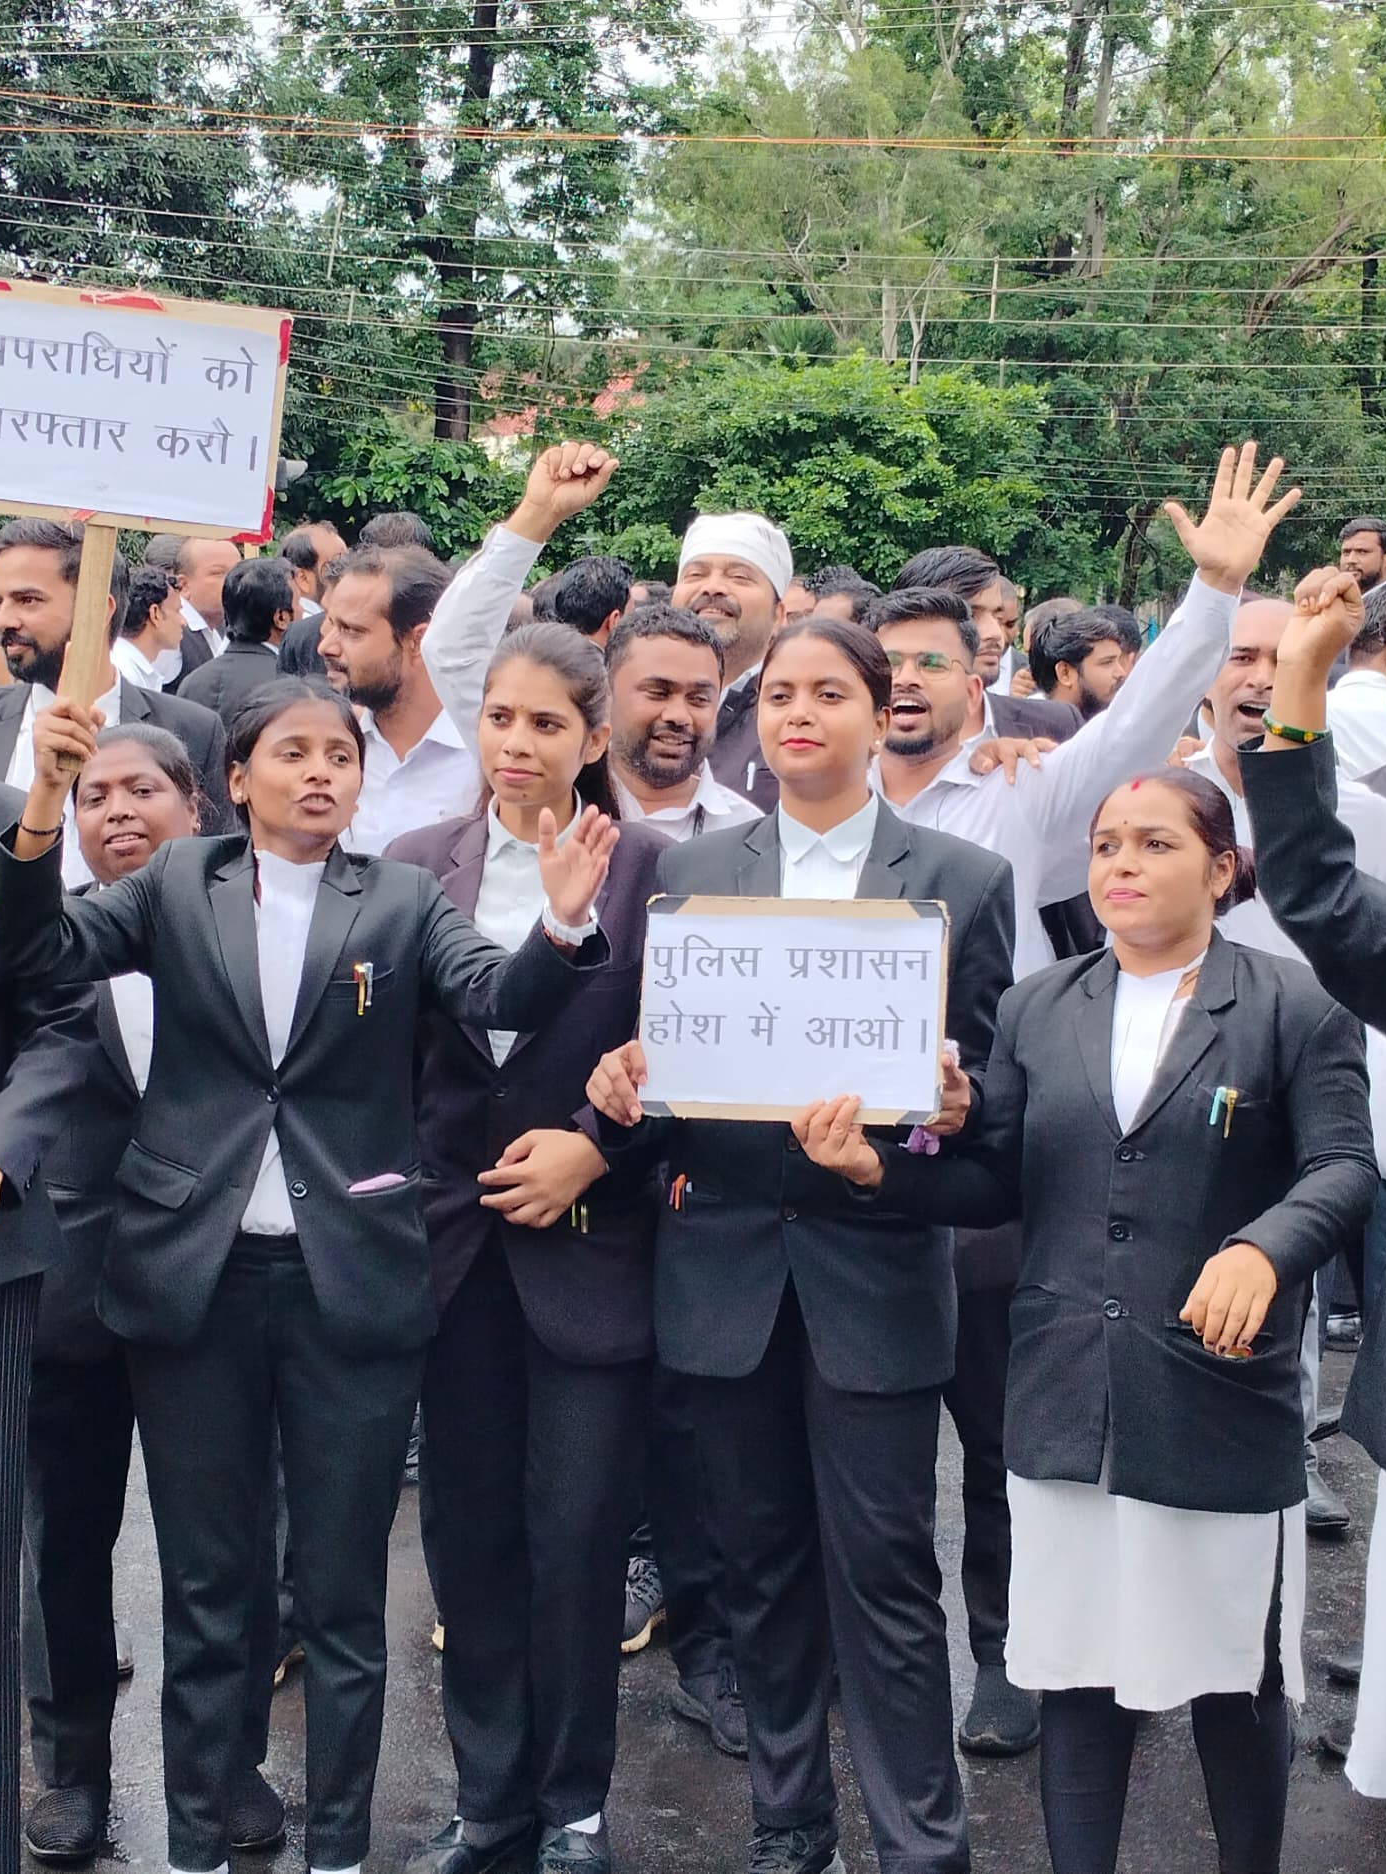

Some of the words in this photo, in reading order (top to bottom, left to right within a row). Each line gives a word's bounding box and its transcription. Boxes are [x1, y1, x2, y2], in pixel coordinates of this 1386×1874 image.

[202, 347, 258, 394] को
[649, 934, 763, 989] पुलिस
[785, 948, 932, 981] प्रशासन
[645, 1000, 727, 1047] होश
[748, 1001, 782, 1047] में
[805, 1005, 904, 1051] आओ
